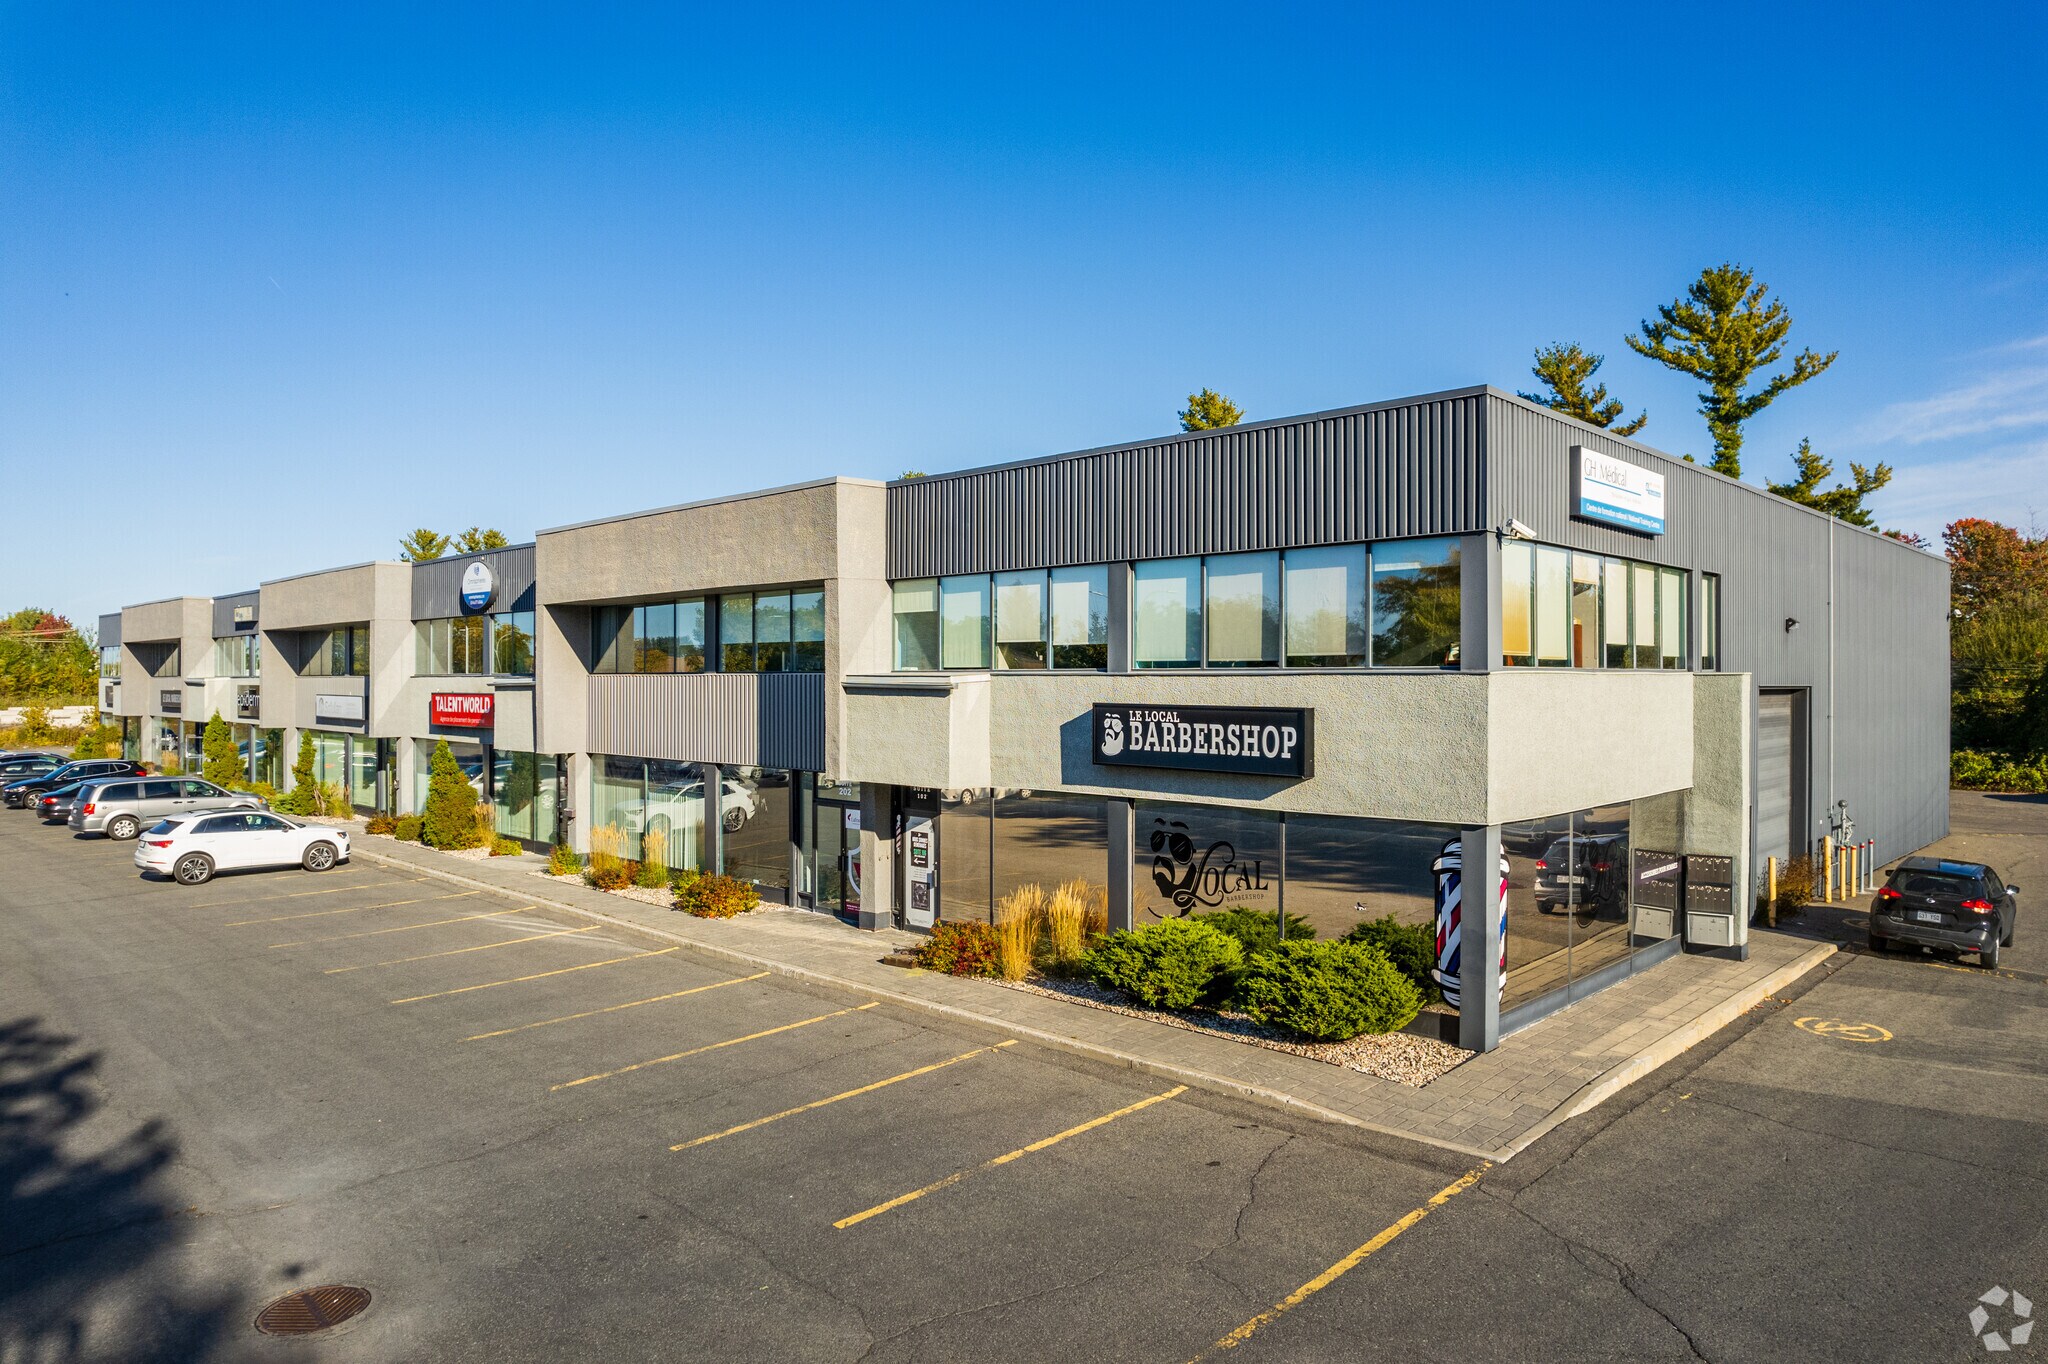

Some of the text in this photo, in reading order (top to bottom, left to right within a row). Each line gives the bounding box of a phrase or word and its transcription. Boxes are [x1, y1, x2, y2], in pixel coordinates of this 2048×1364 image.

[1584, 458, 1597, 478] CH
[435, 696, 490, 713] TALENTWORLD
[1129, 711, 1180, 723] LE LOCAL
[1129, 721, 1297, 759] BARBERSHOP
[839, 787, 852, 796] 202
[1226, 893, 1265, 903] BARBERSHOP
